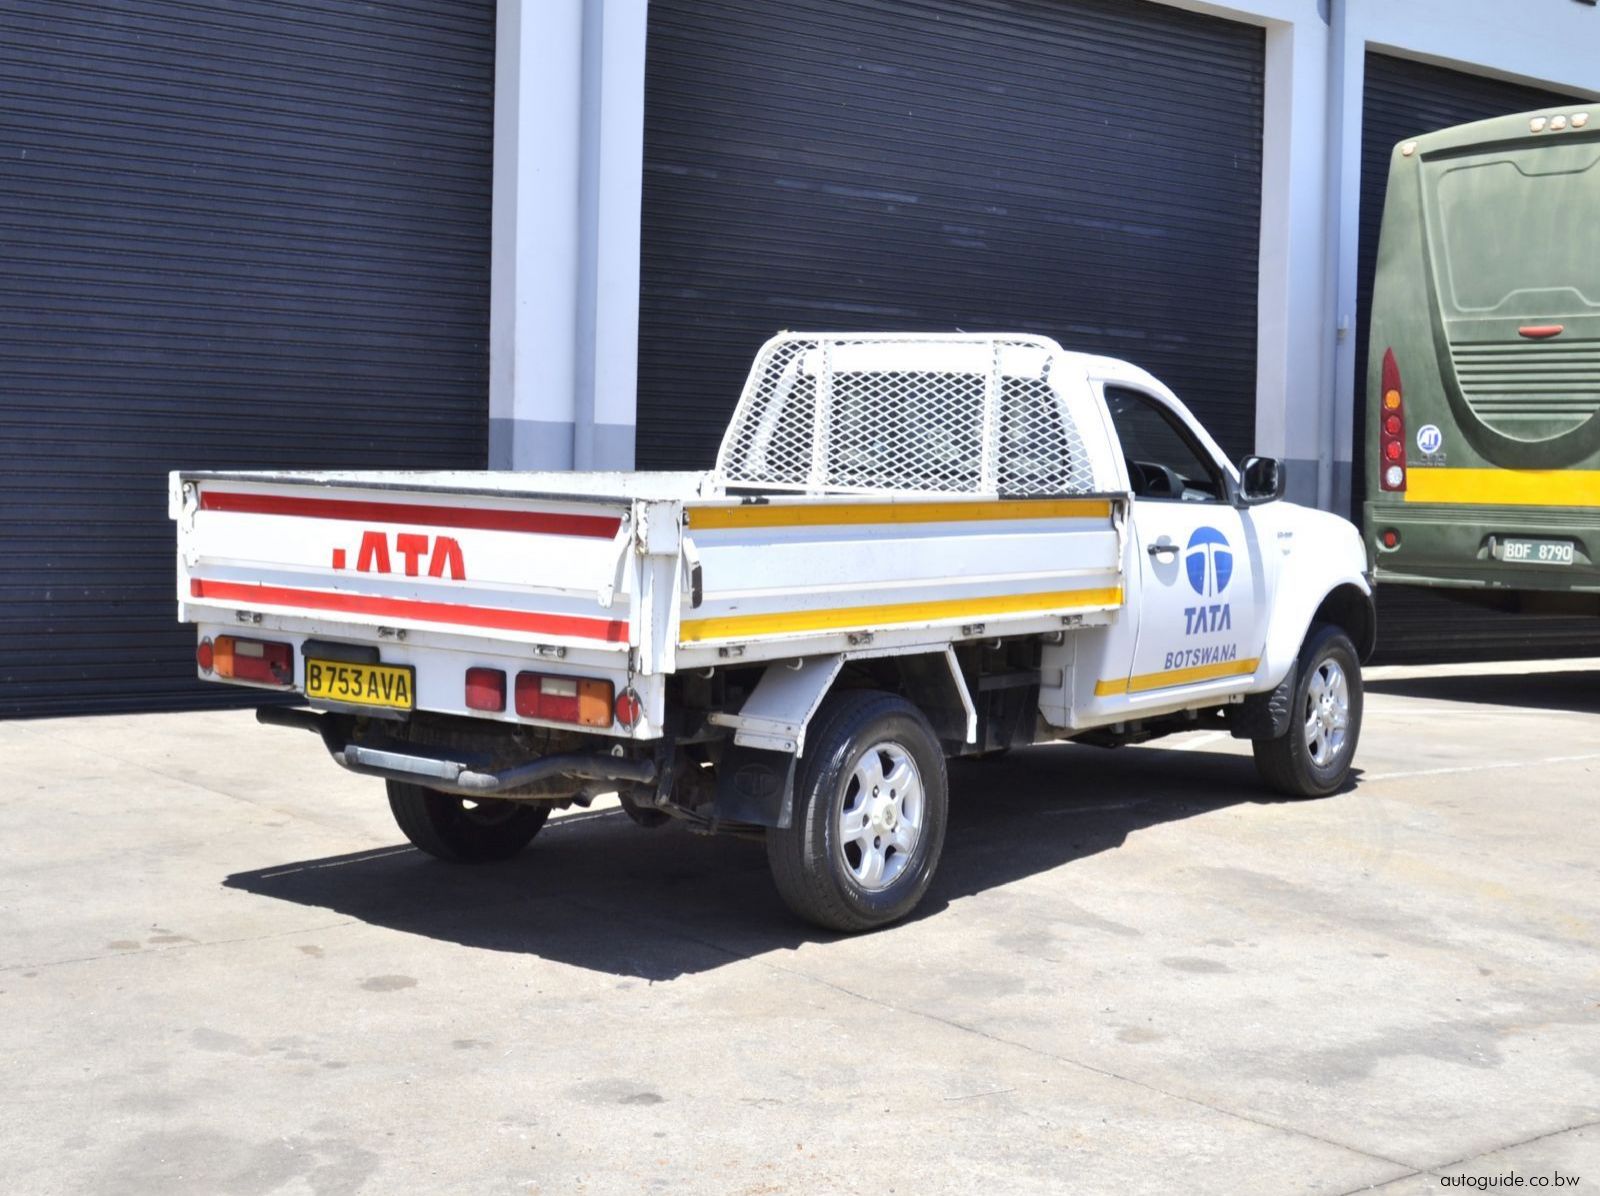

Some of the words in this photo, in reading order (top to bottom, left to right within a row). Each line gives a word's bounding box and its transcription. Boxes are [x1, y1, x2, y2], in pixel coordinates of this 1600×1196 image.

[1539, 544, 1571, 561] 8790
[1184, 603, 1231, 636] TATA
[1164, 643, 1237, 670] BOTSWANA
